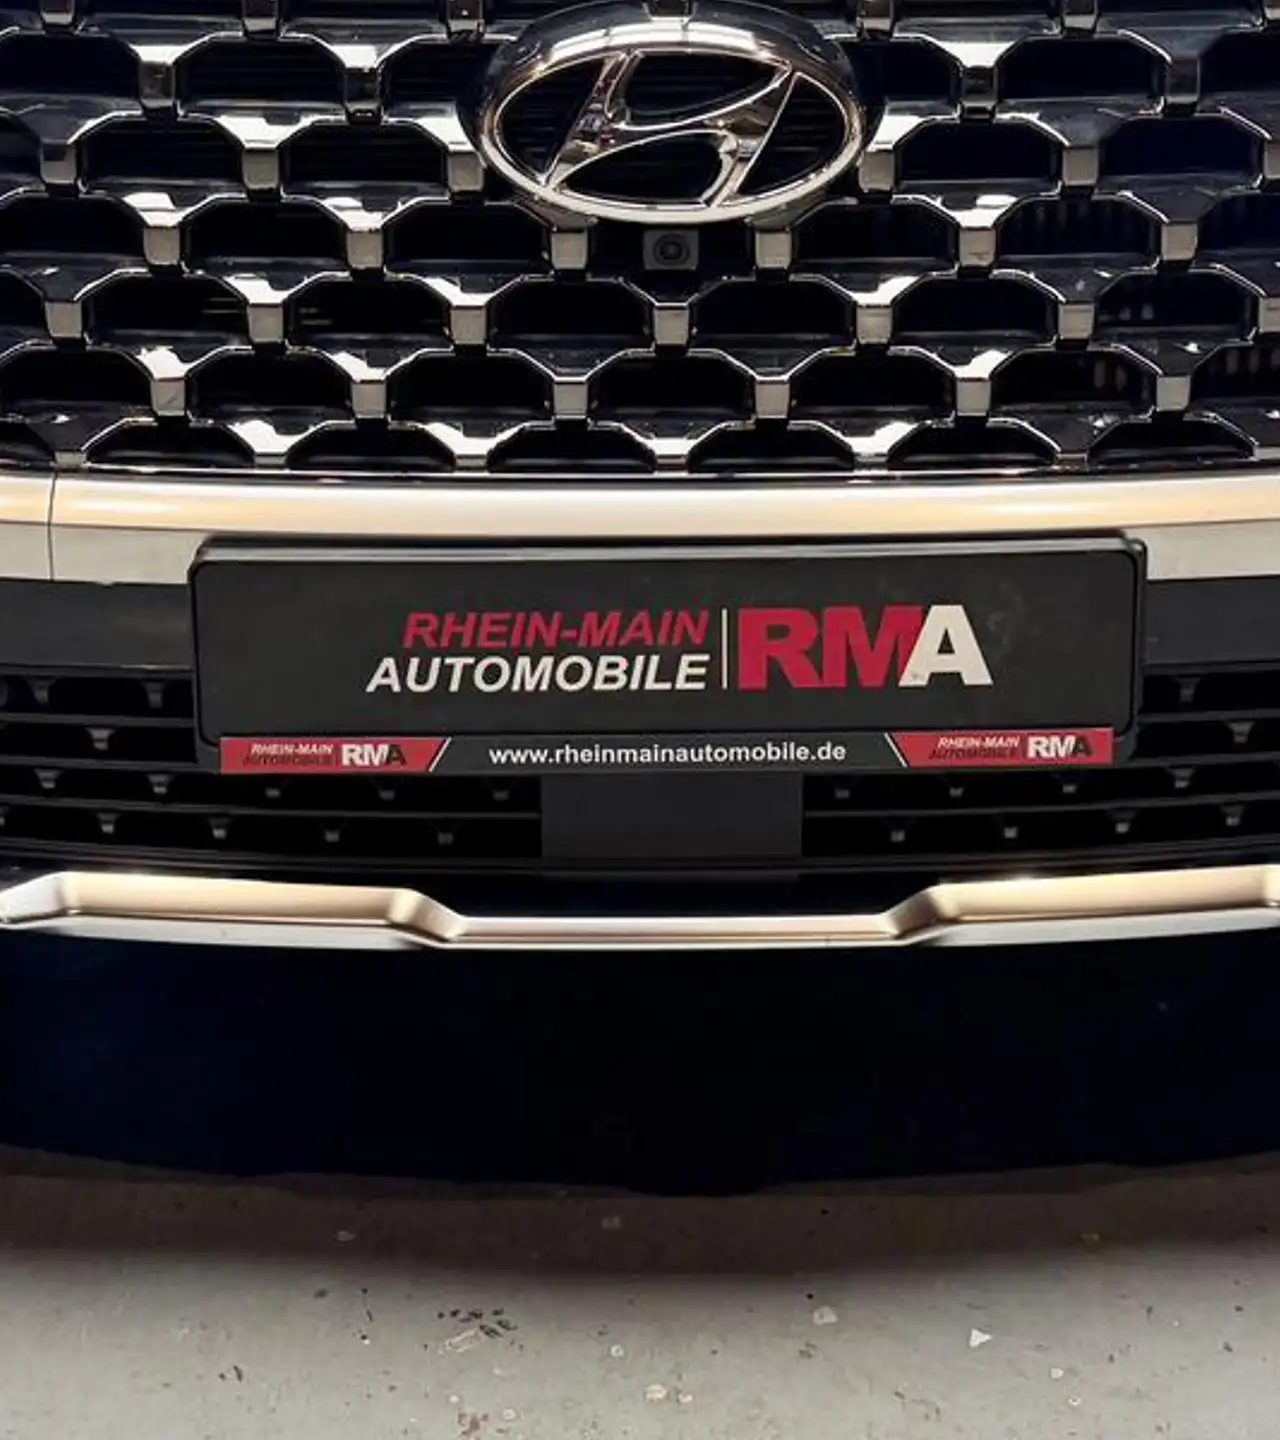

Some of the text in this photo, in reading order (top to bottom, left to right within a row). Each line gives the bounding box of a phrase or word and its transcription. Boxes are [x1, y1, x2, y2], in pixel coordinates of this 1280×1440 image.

[403, 611, 709, 648] RHEIN-MAIN
[738, 605, 993, 689] RMA
[365, 654, 711, 692] AUTOMOBILE
[341, 743, 407, 766] RMA
[489, 741, 846, 764] www.rheinmainautomobile.de
[1027, 735, 1092, 758] RMA
